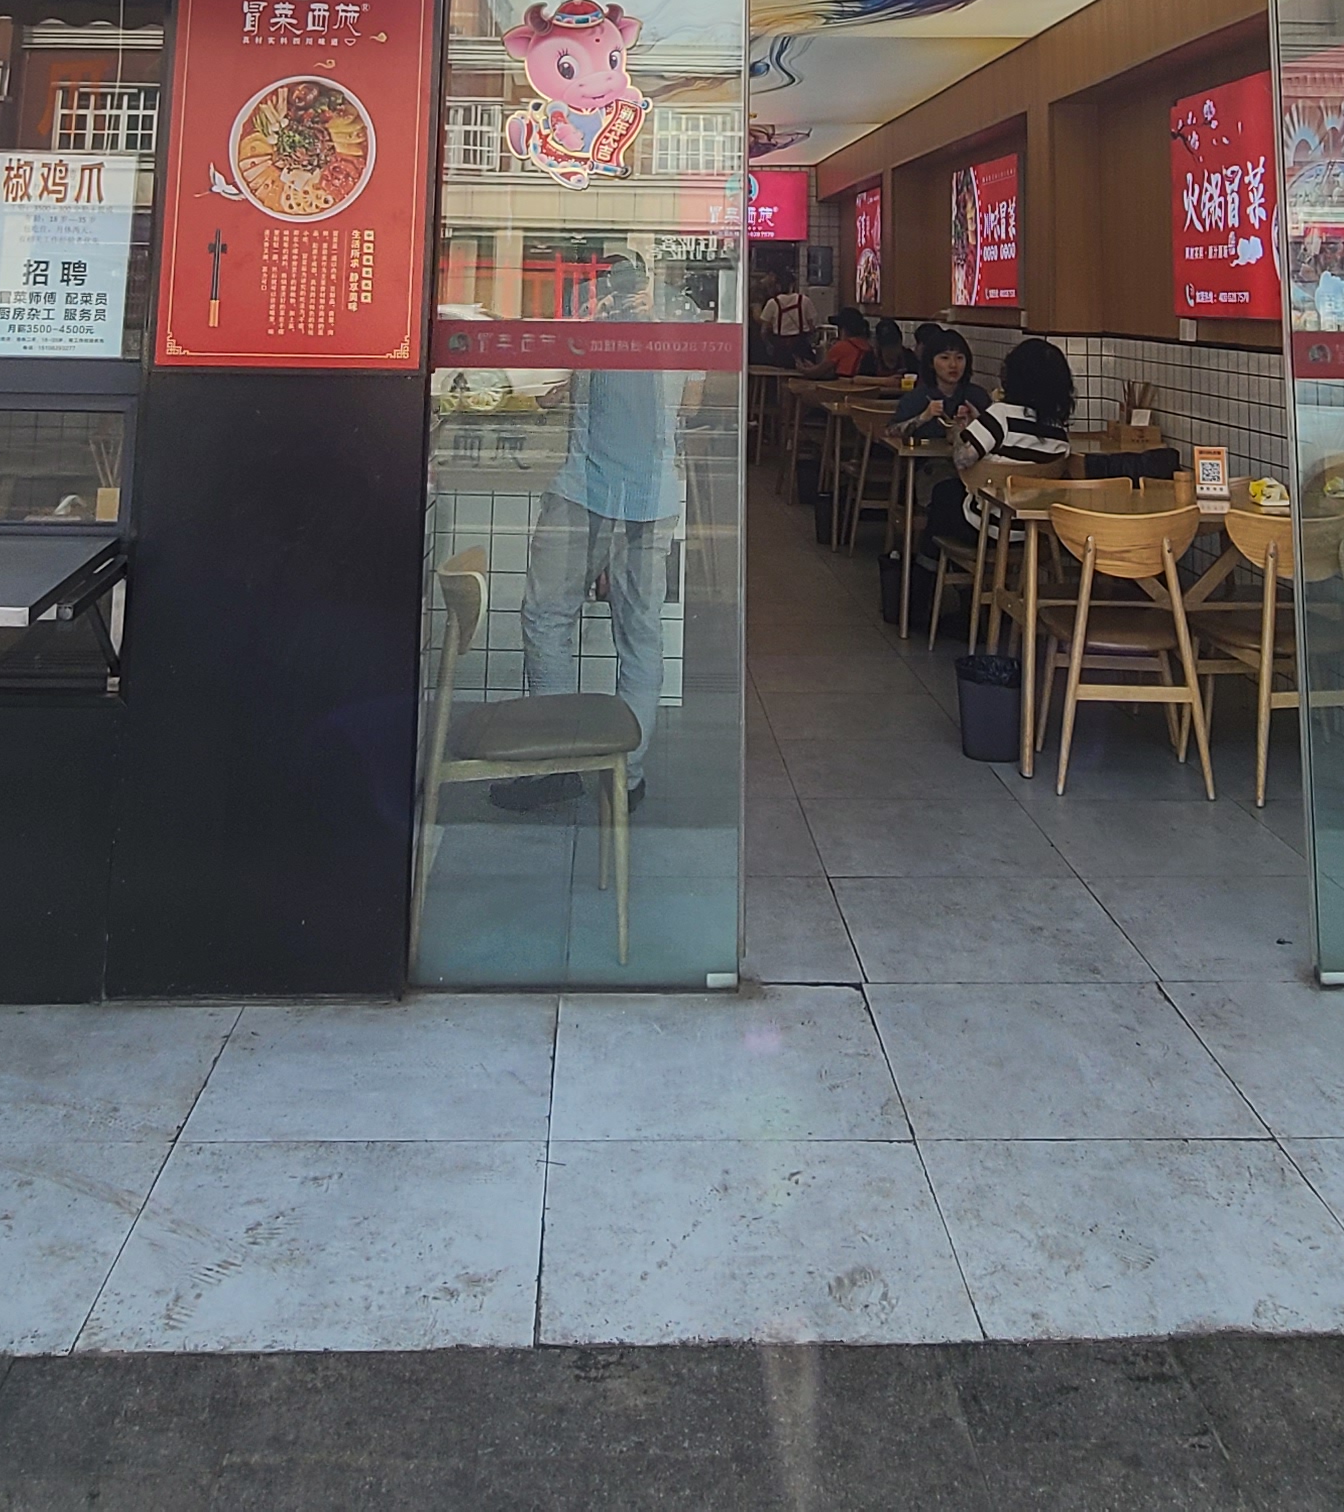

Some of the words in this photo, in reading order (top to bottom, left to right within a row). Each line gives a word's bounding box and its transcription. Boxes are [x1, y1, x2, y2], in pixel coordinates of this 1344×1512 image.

[242, 0, 362, 37] 冒菜西施
[1183, 156, 1267, 233] 火锅冒菜
[22, 259, 88, 287] 招聘
[0, 291, 57, 305] 冒菜师傅
[65, 292, 108, 306] 配菜员
[63, 308, 107, 322] 服务员
